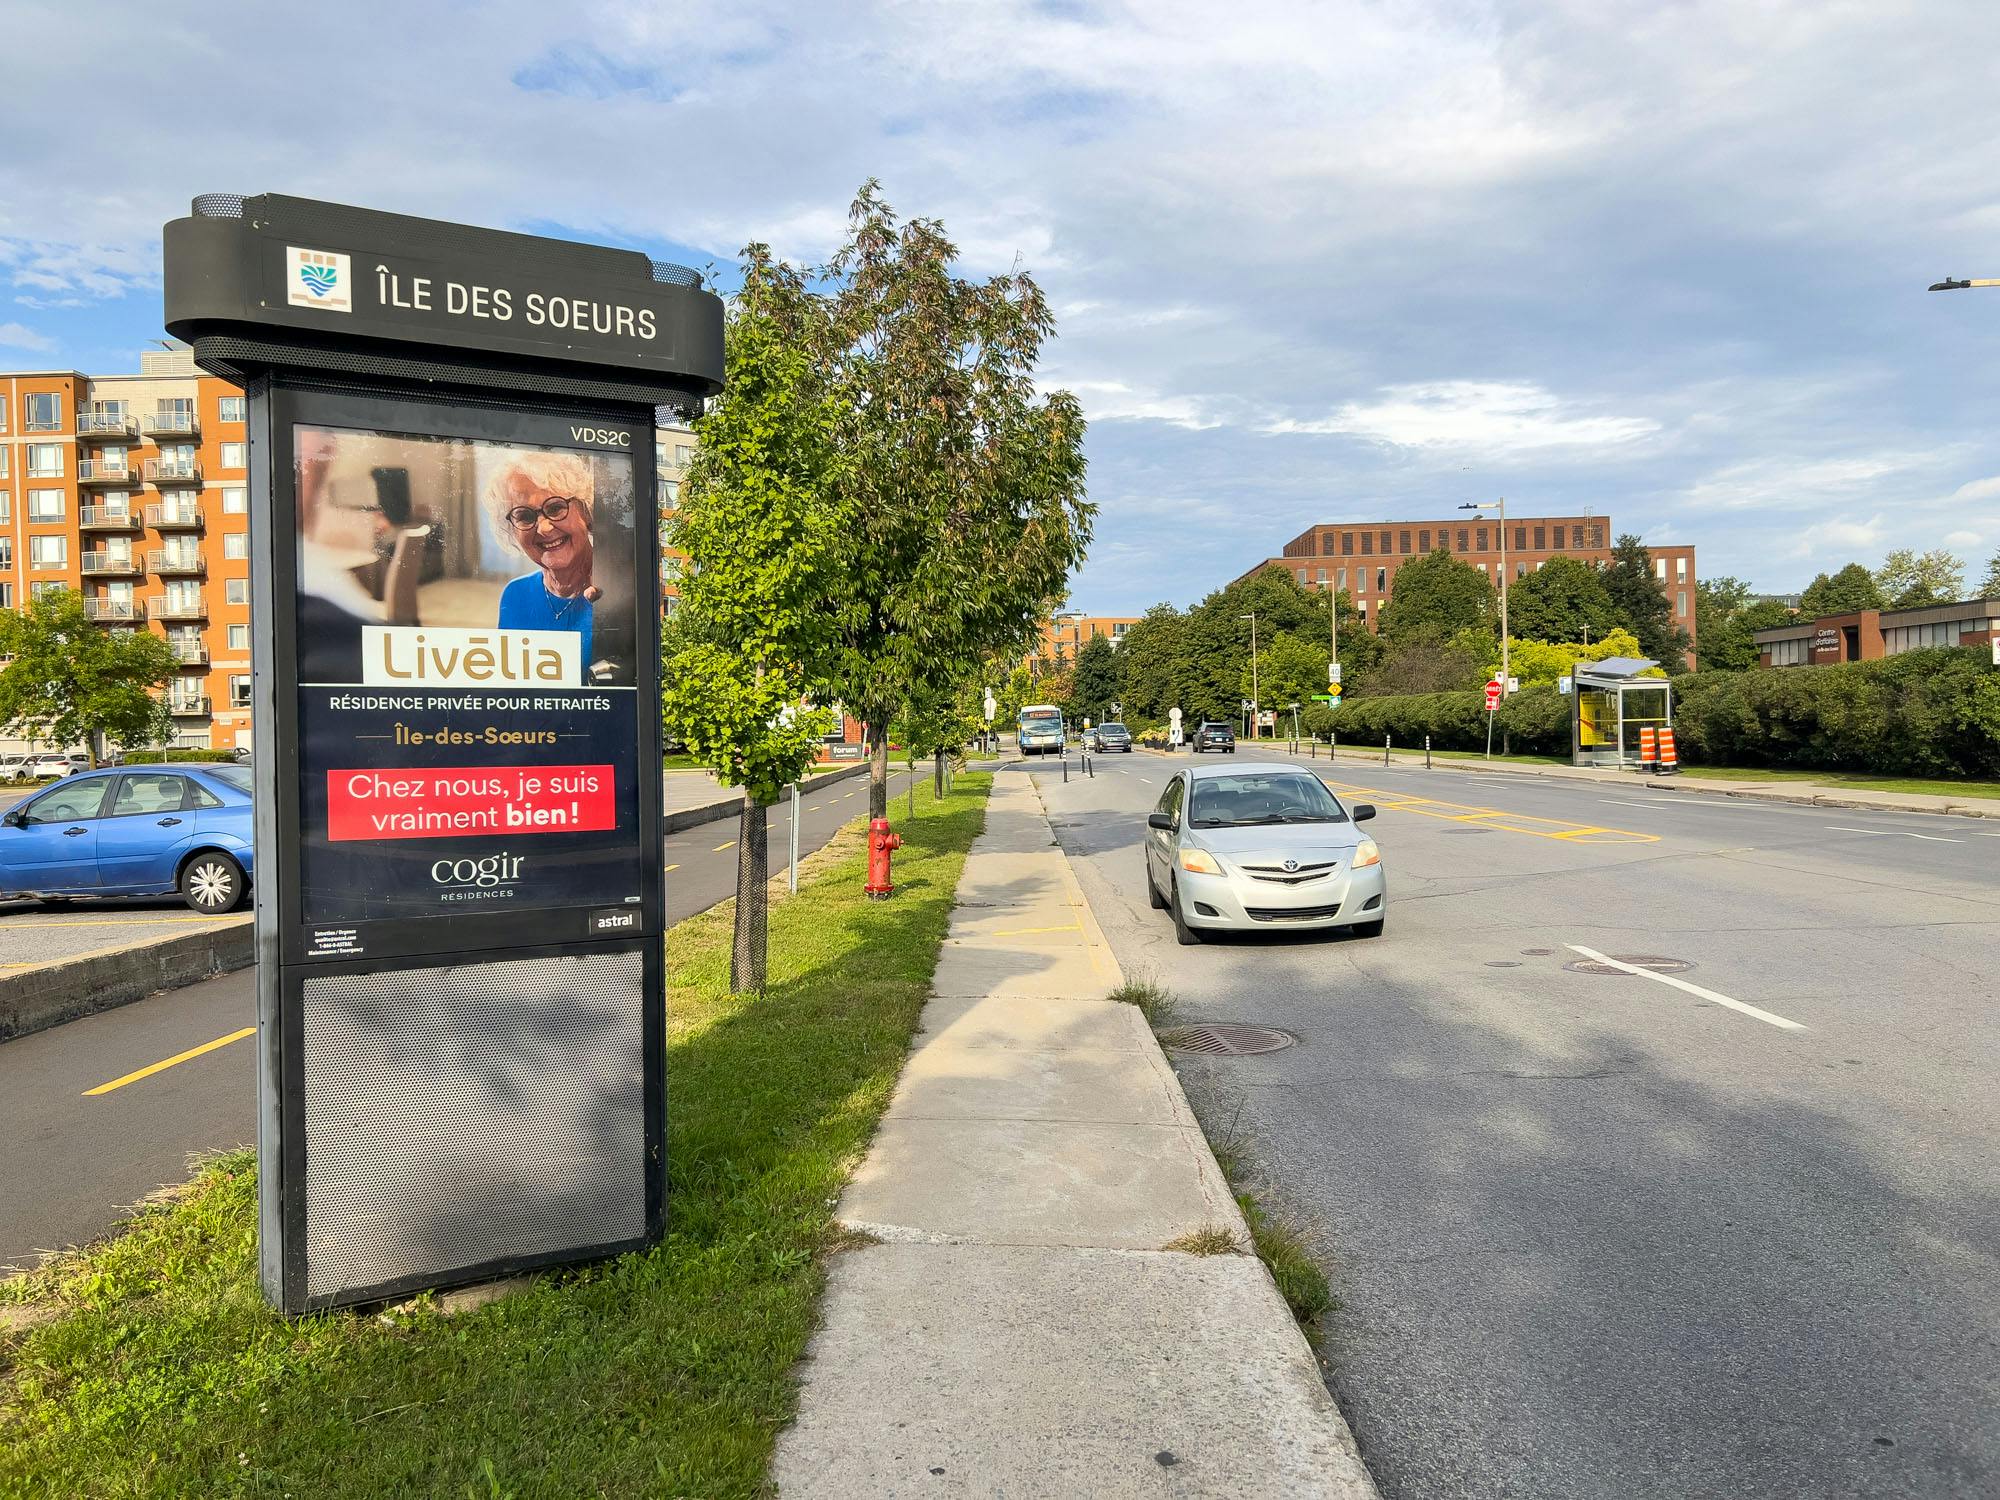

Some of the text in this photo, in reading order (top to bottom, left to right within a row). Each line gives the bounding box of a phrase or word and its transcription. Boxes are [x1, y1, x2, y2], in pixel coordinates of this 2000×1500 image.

[375, 264, 657, 340] ÎLE DES SOEURS
[570, 426, 631, 447] VDS2C
[384, 632, 563, 681] Livēlia
[330, 693, 611, 711] RÉSIDENCE PRIVÉE POUR RETRAITÉS
[394, 722, 557, 745] Île-des-Sœurs
[348, 770, 600, 802] Chez nous, je suis
[371, 806, 499, 832] vraiment
[431, 851, 525, 888] cogir
[441, 889, 514, 901] RÉSIDENCES
[597, 913, 633, 928] astral
